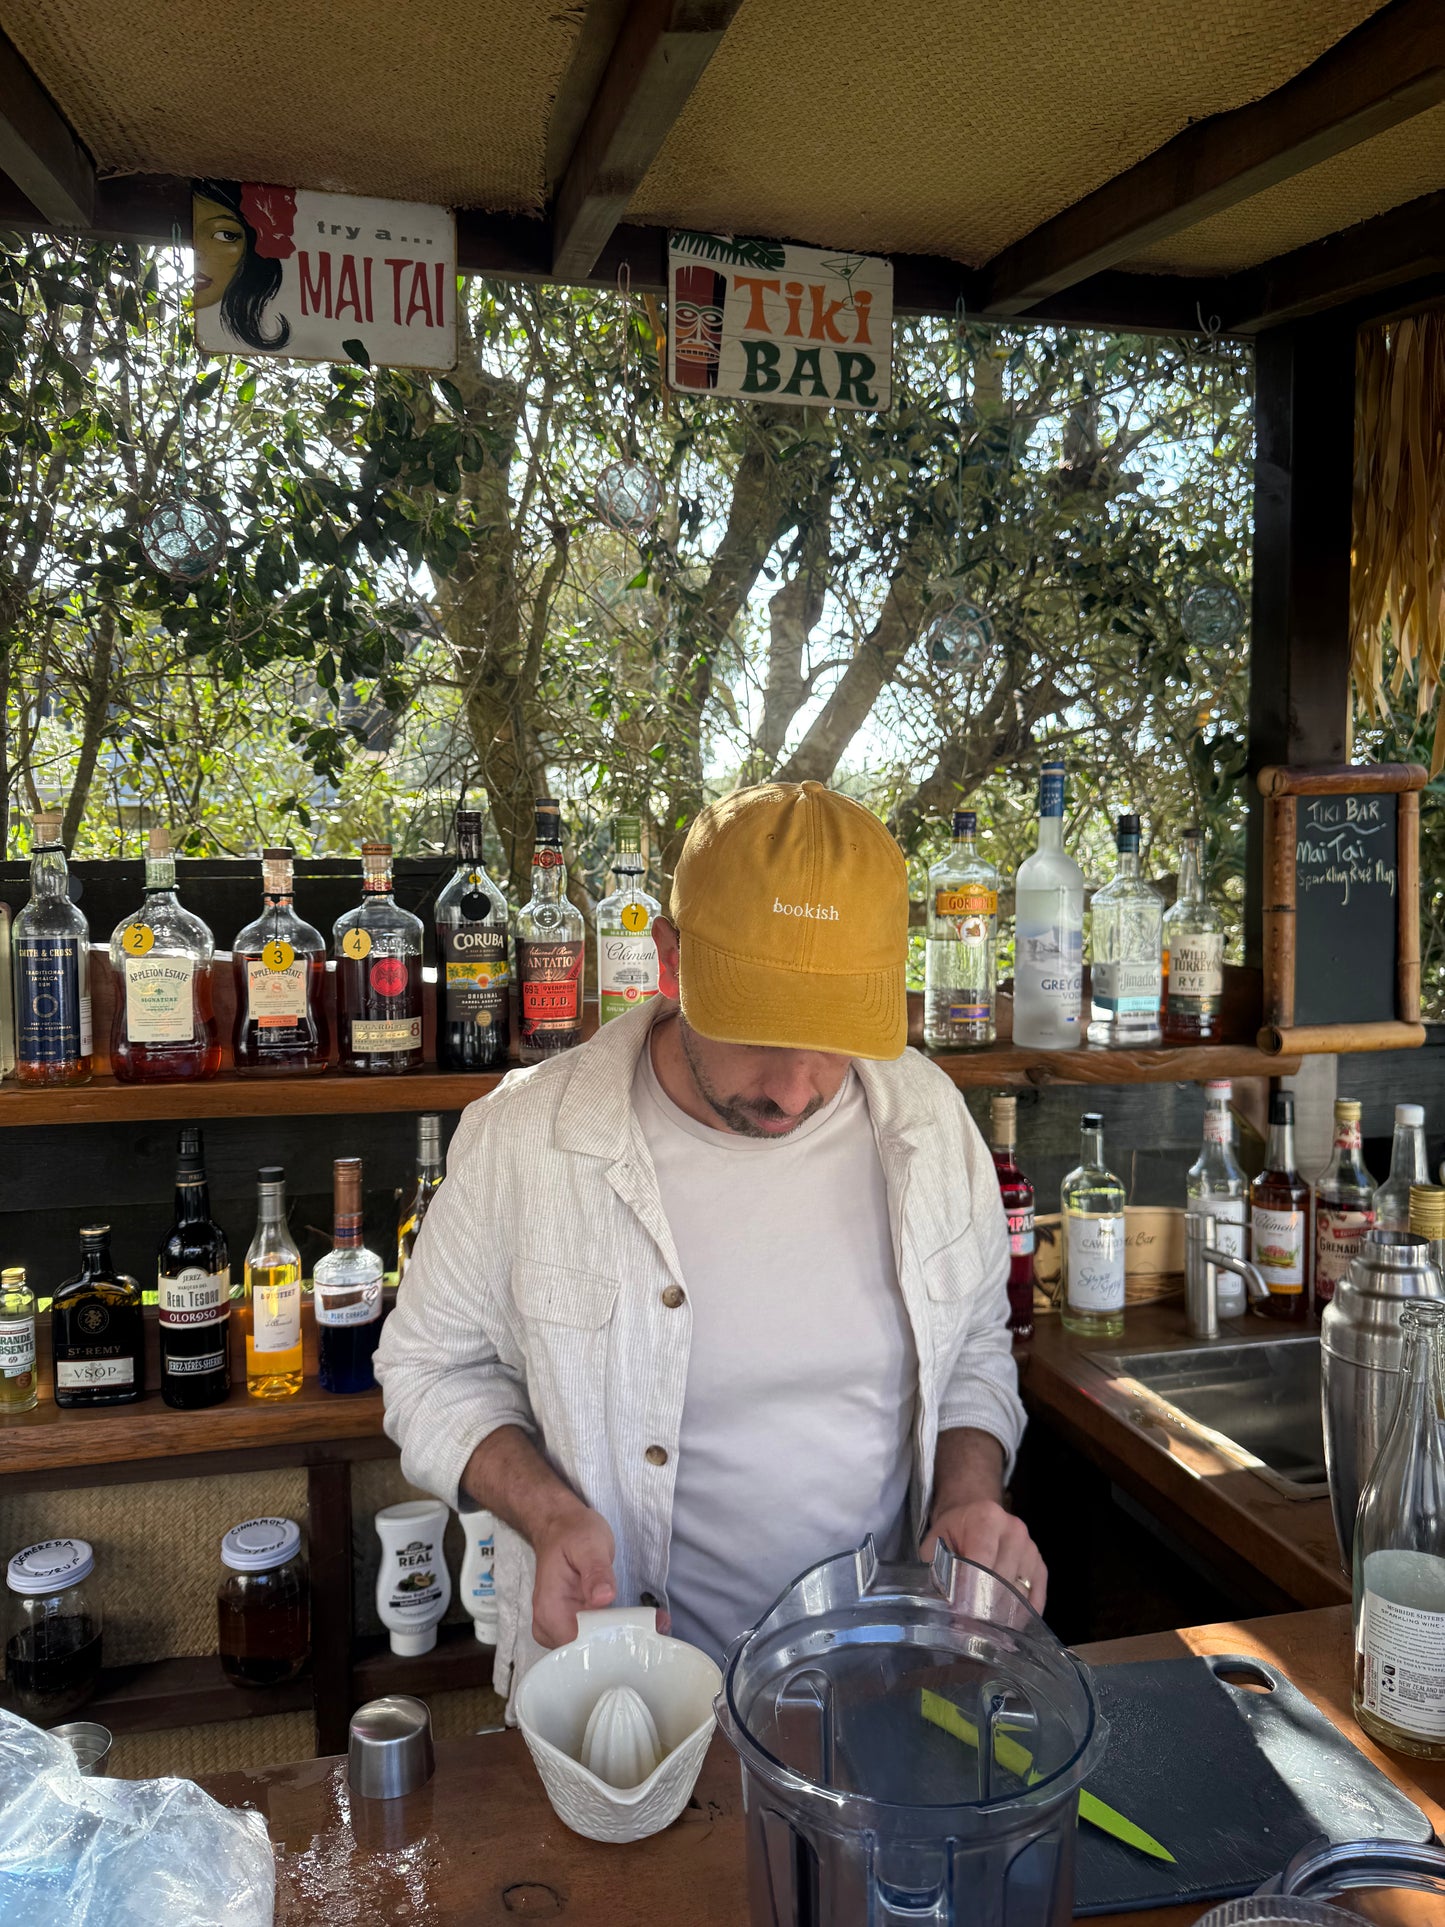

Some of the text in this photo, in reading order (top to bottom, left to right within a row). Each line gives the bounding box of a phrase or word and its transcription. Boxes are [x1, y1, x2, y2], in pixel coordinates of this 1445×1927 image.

[316, 220, 361, 240] try
[298, 250, 445, 328] MAI TAI
[733, 274, 873, 346] Tiki
[739, 340, 879, 408] BAR
[1307, 797, 1380, 823] TIKI BAR
[1296, 832, 1365, 864] Mai Tai
[773, 897, 840, 921] bookish
[631, 912, 639, 925] 7
[133, 933, 144, 948] 2
[352, 938, 362, 952] 4
[453, 932, 504, 951] CORUBA
[273, 950, 283, 965] 3
[605, 941, 657, 962] Clément
[1179, 948, 1207, 961] WILD
[1172, 956, 1212, 972] TURKEY
[129, 967, 190, 983] APPLETON ESTATE
[1178, 976, 1206, 987] RYE
[1041, 978, 1071, 990] GREY
[467, 992, 499, 1000] ORIGINAL
[410, 1021, 421, 1037] 8
[183, 1273, 202, 1283] JEREZ
[166, 1288, 219, 1308] REAL TESORO
[169, 1309, 217, 1322] OLOROSO
[8, 1355, 18, 1364] 69
[73, 1365, 117, 1379] VSOP
[231, 1519, 287, 1536] CINNAMON
[13, 1540, 74, 1567] DEMERERA
[398, 1552, 433, 1568] REAL
[34, 1557, 81, 1576] SYRUP
[1381, 1608, 1440, 1629] SPARKLING WINE
[1416, 1614, 1444, 1622] SISTERS
[1412, 1683, 1438, 1694] ZEALAND
